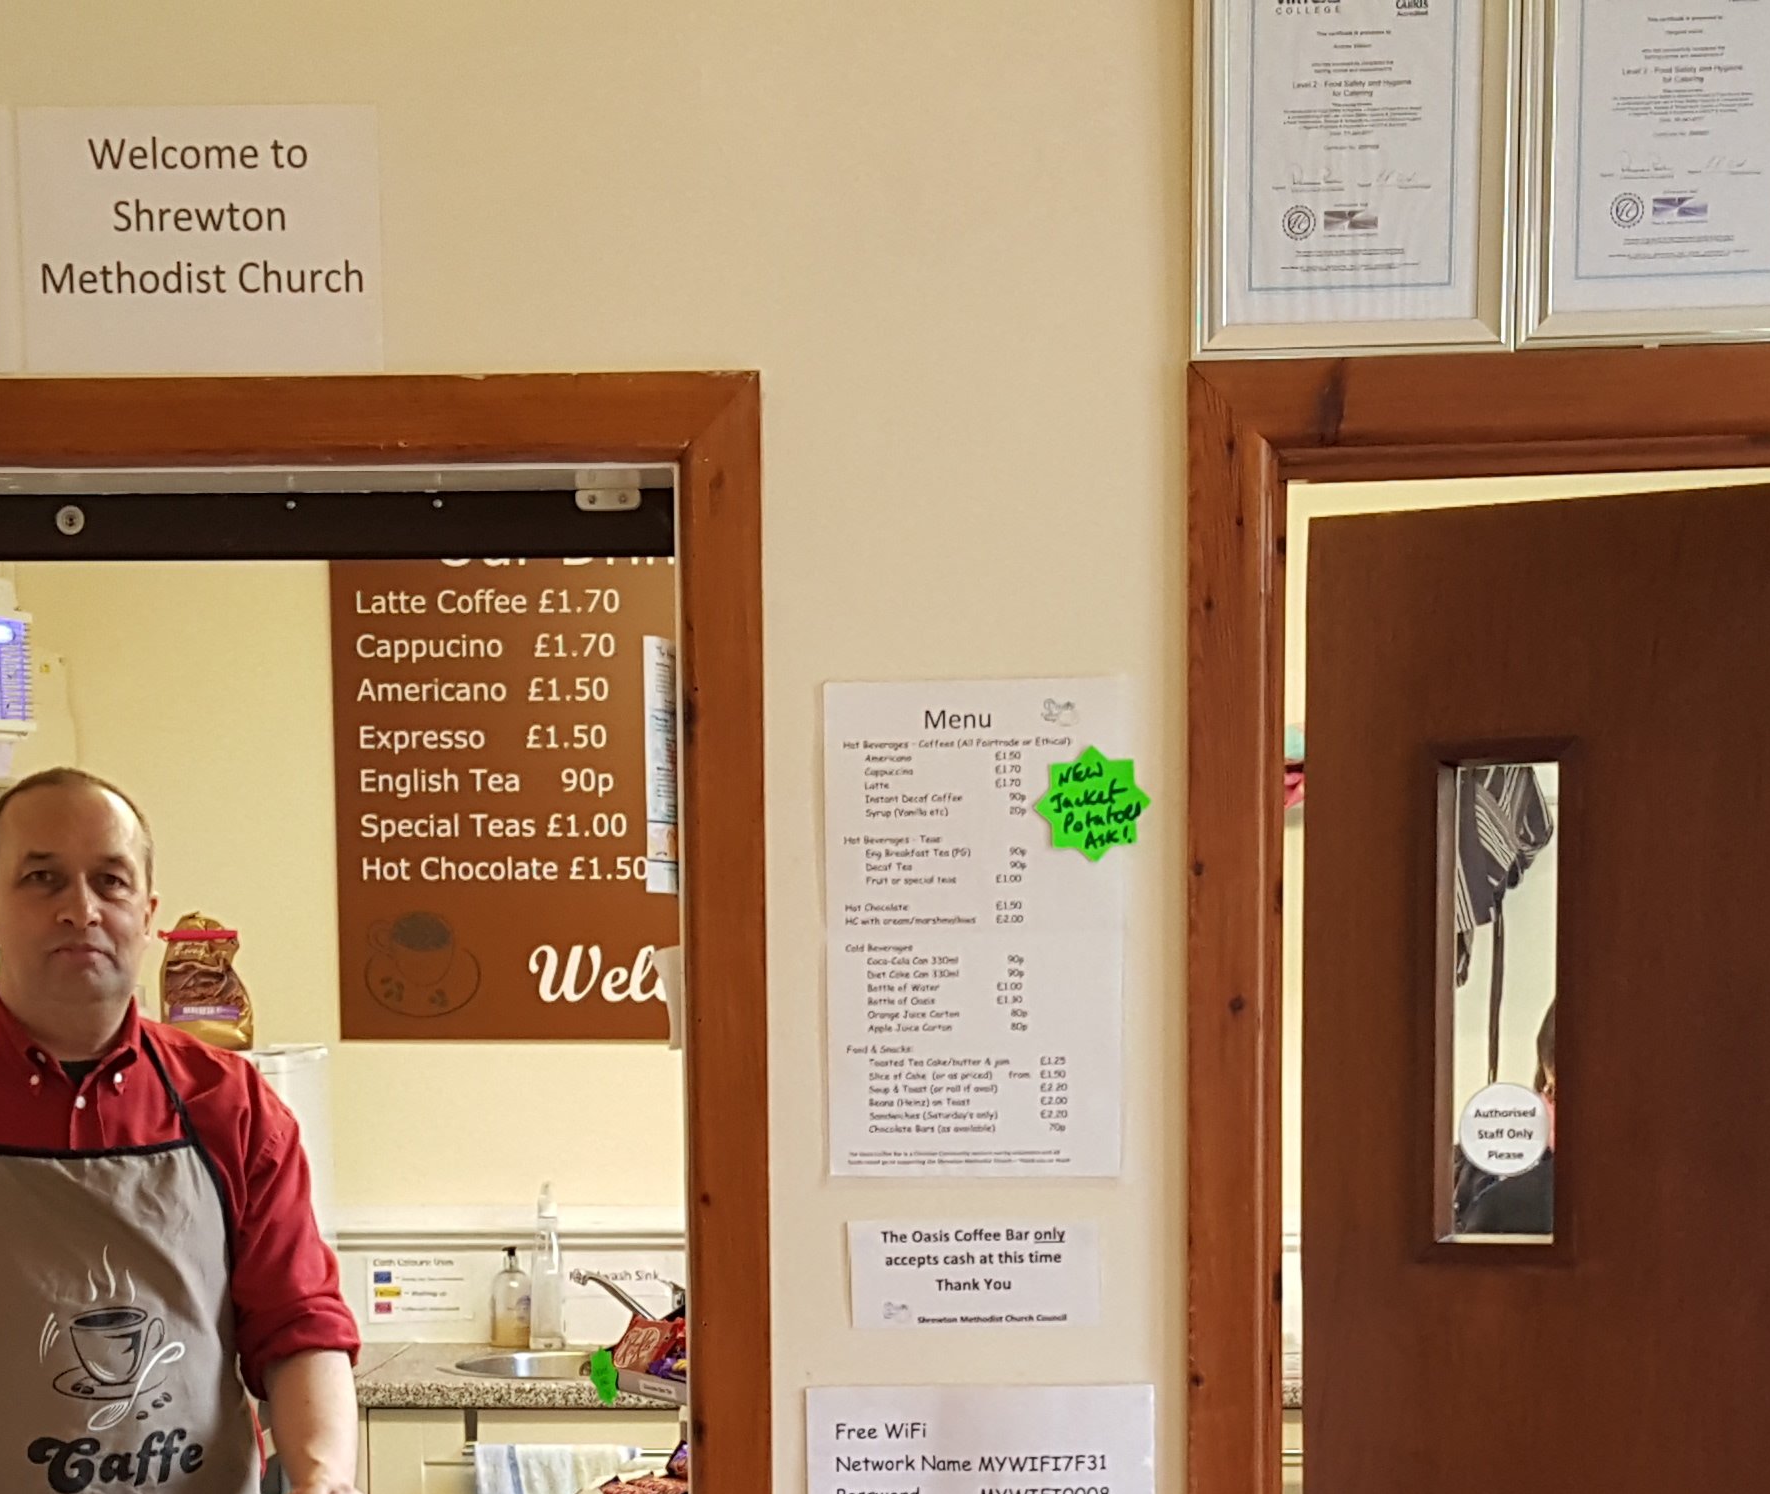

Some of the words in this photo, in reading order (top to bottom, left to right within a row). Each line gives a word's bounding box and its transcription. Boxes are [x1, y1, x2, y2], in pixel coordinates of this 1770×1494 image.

[88, 138, 258, 171] Welcome
[271, 141, 308, 170] to
[113, 199, 287, 233] Shrewton
[40, 261, 227, 296] Methodist
[238, 261, 364, 295] Church
[355, 591, 426, 614] Latte
[437, 588, 527, 614] Coffee
[538, 589, 620, 614] £1.70
[356, 634, 503, 663] Cappucino
[535, 634, 615, 658] £1.70
[357, 678, 507, 702] Americano
[528, 677, 609, 702] £1.50
[924, 710, 992, 730] Menu
[359, 725, 486, 754] Expresso
[526, 725, 607, 749] £1.50
[863, 740, 909, 751] Beverages
[865, 754, 912, 763] Americano
[360, 768, 459, 797] English
[470, 769, 520, 792] Tea
[561, 769, 614, 797] 90p
[1058, 762, 1104, 787] NEW
[865, 781, 889, 790] Latte
[866, 794, 899, 804] Instant
[902, 793, 928, 804] Decaf
[932, 793, 963, 803] Coffee
[1050, 780, 1128, 813] Jacket
[866, 808, 891, 819] Syrup
[360, 814, 460, 841] Special
[470, 815, 536, 838] Teas
[547, 814, 627, 838] £1.00
[362, 857, 411, 881] Hot
[421, 857, 558, 881] Chocolate
[569, 857, 648, 881] £1.50
[529, 944, 666, 1003] Wel
[868, 1023, 893, 1033] Apple
[1474, 1108, 1536, 1118] Authorised
[1478, 1128, 1504, 1140] Staff
[1506, 1129, 1533, 1140] Only
[1487, 1150, 1524, 1160] Please
[881, 1231, 908, 1243] The
[912, 1230, 949, 1243] Oasis
[954, 1228, 1001, 1242] Coffee
[1006, 1229, 1029, 1242] Bar
[1034, 1227, 1065, 1243] only
[885, 1253, 939, 1268] accepts
[944, 1252, 975, 1265] cash
[980, 1253, 994, 1264] at
[999, 1251, 1024, 1264] this
[1029, 1251, 1061, 1264] time
[936, 1279, 979, 1291] Thank
[984, 1279, 1012, 1291] You
[960, 1315, 1002, 1324] Methodist
[1005, 1314, 1034, 1323] Church
[1037, 1313, 1067, 1322] Council
[836, 1423, 877, 1440] Free
[885, 1422, 927, 1440] WiFi
[27, 1428, 203, 1494] Caffe
[836, 1456, 916, 1473] Network
[921, 1456, 971, 1473] Name
[979, 1455, 1107, 1472] MYWIFI7F31
